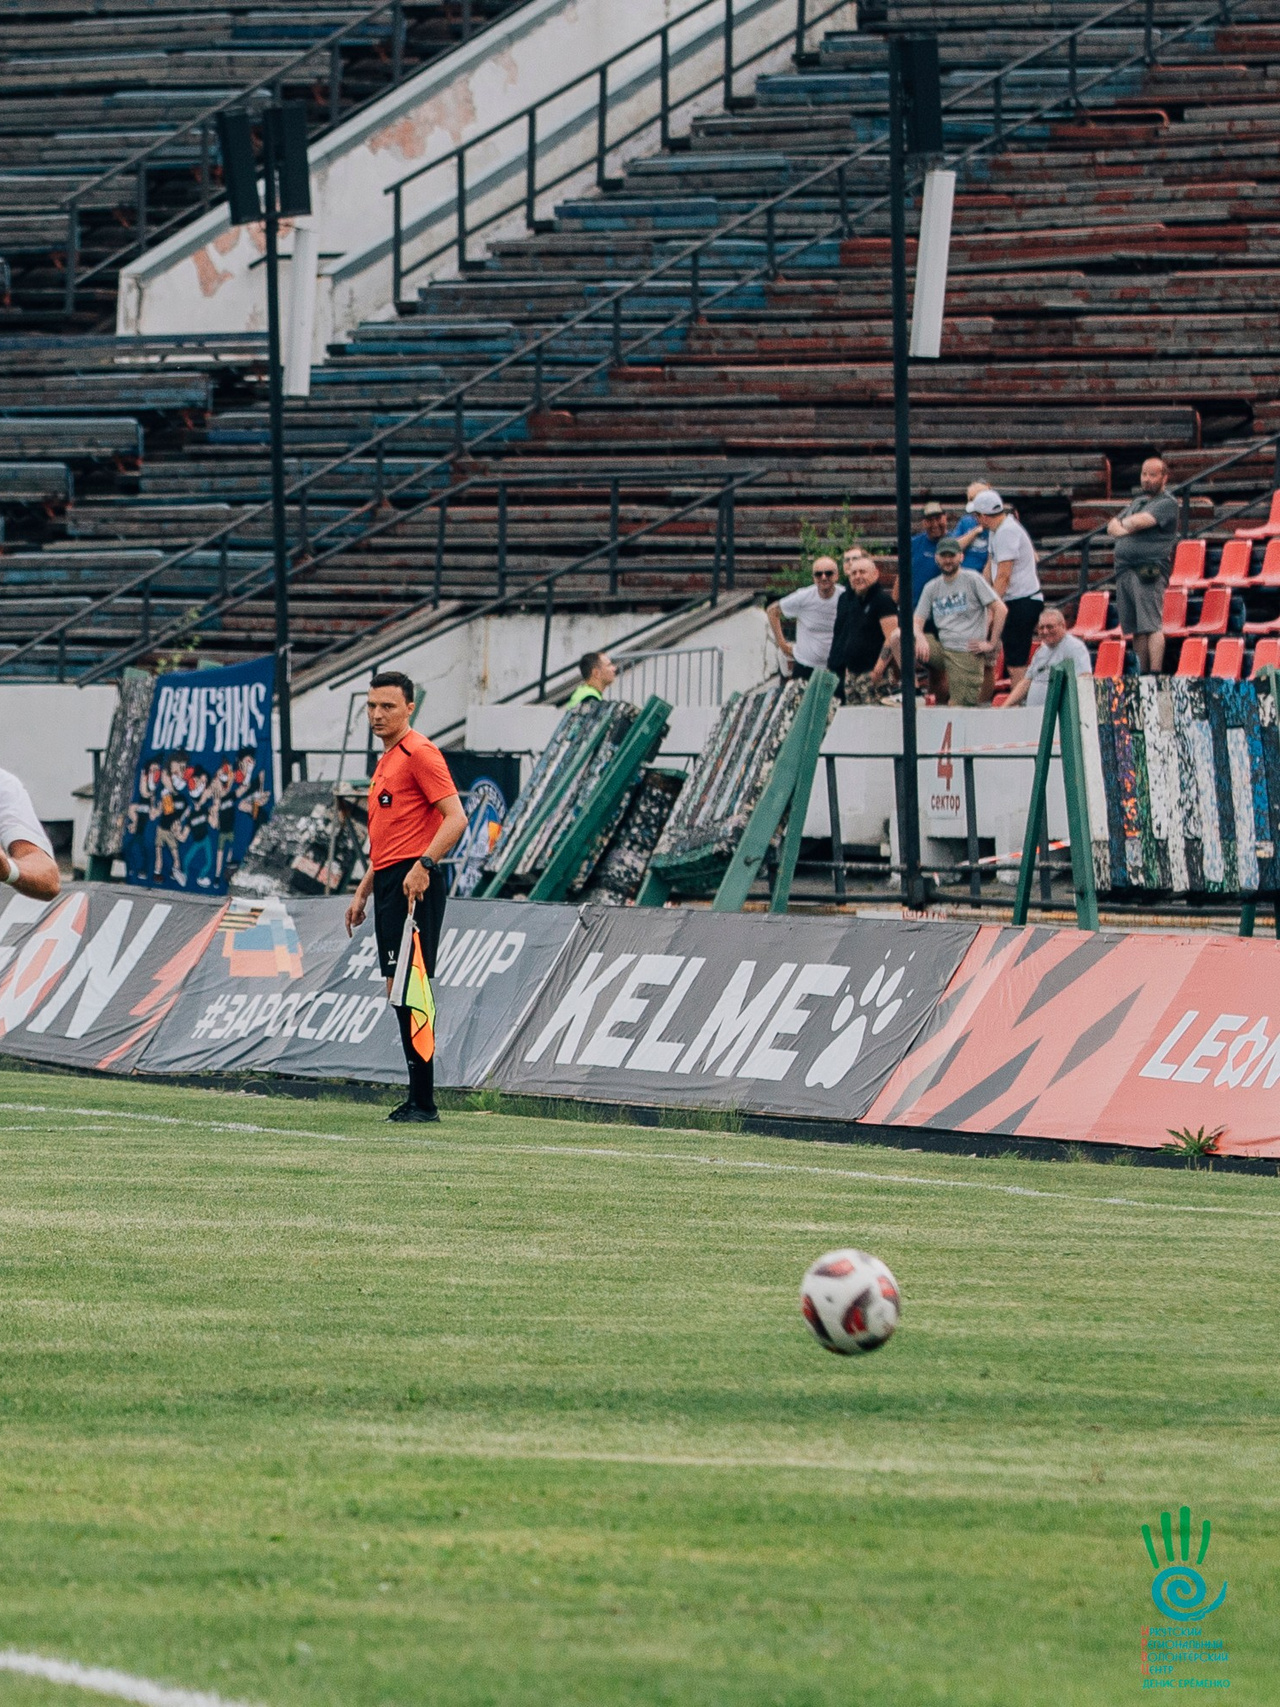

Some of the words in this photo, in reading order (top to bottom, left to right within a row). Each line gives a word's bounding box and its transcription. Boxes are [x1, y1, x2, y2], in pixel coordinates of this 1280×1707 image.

[937, 721, 953, 791] 4
[382, 795, 389, 803] 2
[190, 991, 388, 1044] #ЗАРОССИЮ
[524, 952, 851, 1081] KELME
